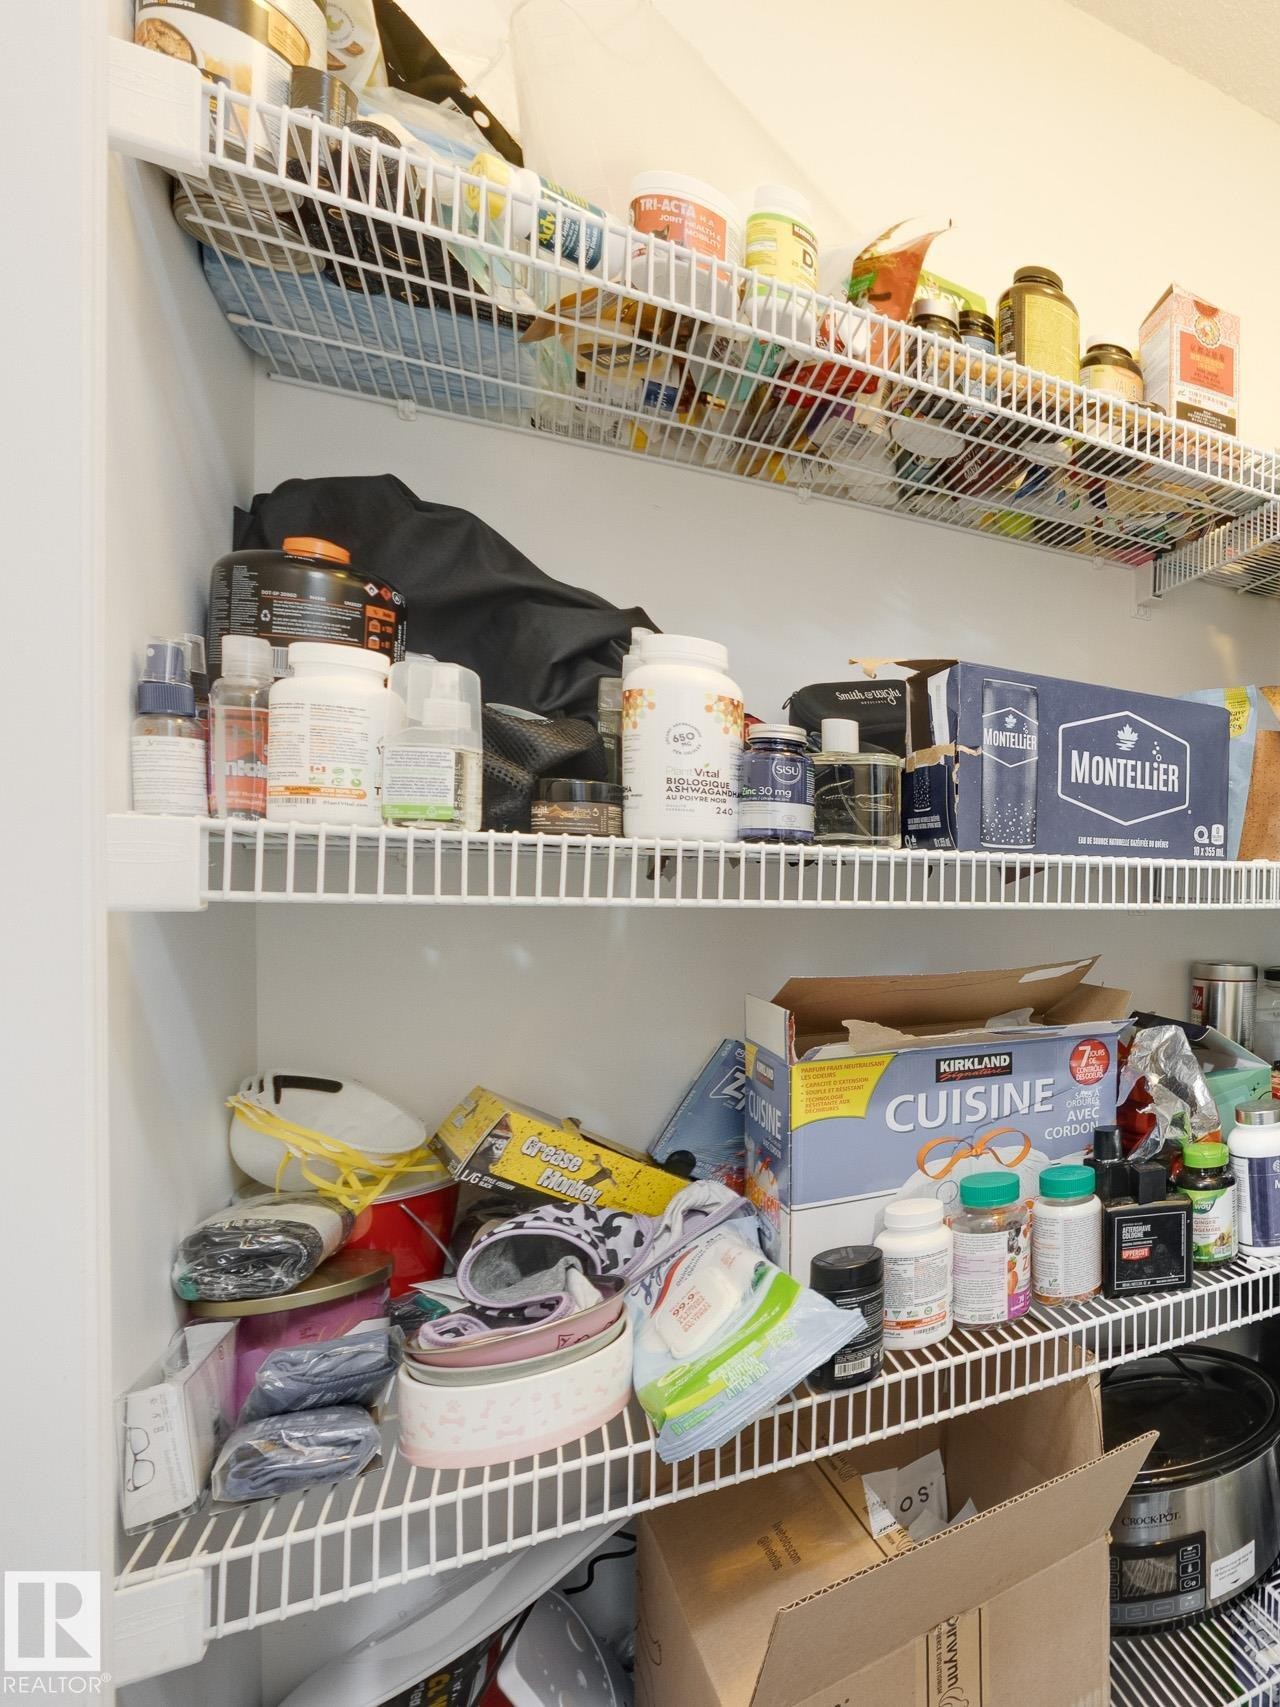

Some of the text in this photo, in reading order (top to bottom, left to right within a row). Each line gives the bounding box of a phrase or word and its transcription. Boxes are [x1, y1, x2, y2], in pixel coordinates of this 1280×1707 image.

[639, 198, 695, 217] TRI-ACTA
[836, 690, 865, 702] Smith
[672, 731, 696, 745] 650
[666, 777, 731, 791] BIOLOGIQUE
[666, 785, 743, 800] ASHWAGANDHA
[679, 795, 708, 804] POIVRE
[709, 797, 728, 805] NOIR
[742, 786, 793, 799] Zinc 30 mg
[715, 806, 735, 817] 240
[1193, 846, 1200, 857] 10
[1205, 846, 1216, 857] 355
[939, 1055, 1010, 1073] KIRKLAND
[1078, 1045, 1092, 1068] 7
[801, 1060, 885, 1074] PARFUM FRAIS NEUTRALISANT
[811, 1072, 836, 1080] ODEURS
[884, 1077, 1056, 1133] CUISINE
[749, 1089, 782, 1141] CUISINE
[1066, 1106, 1100, 1123] AVEC
[1044, 1119, 1100, 1140] CORDON
[521, 1135, 583, 1172] Grease
[461, 1169, 482, 1185] L/G
[536, 1167, 604, 1207] Monkey
[1121, 1231, 1144, 1240] COLOGNE
[1121, 1247, 1151, 1260] UPPERCUT
[725, 1361, 770, 1401] ATTENTION
